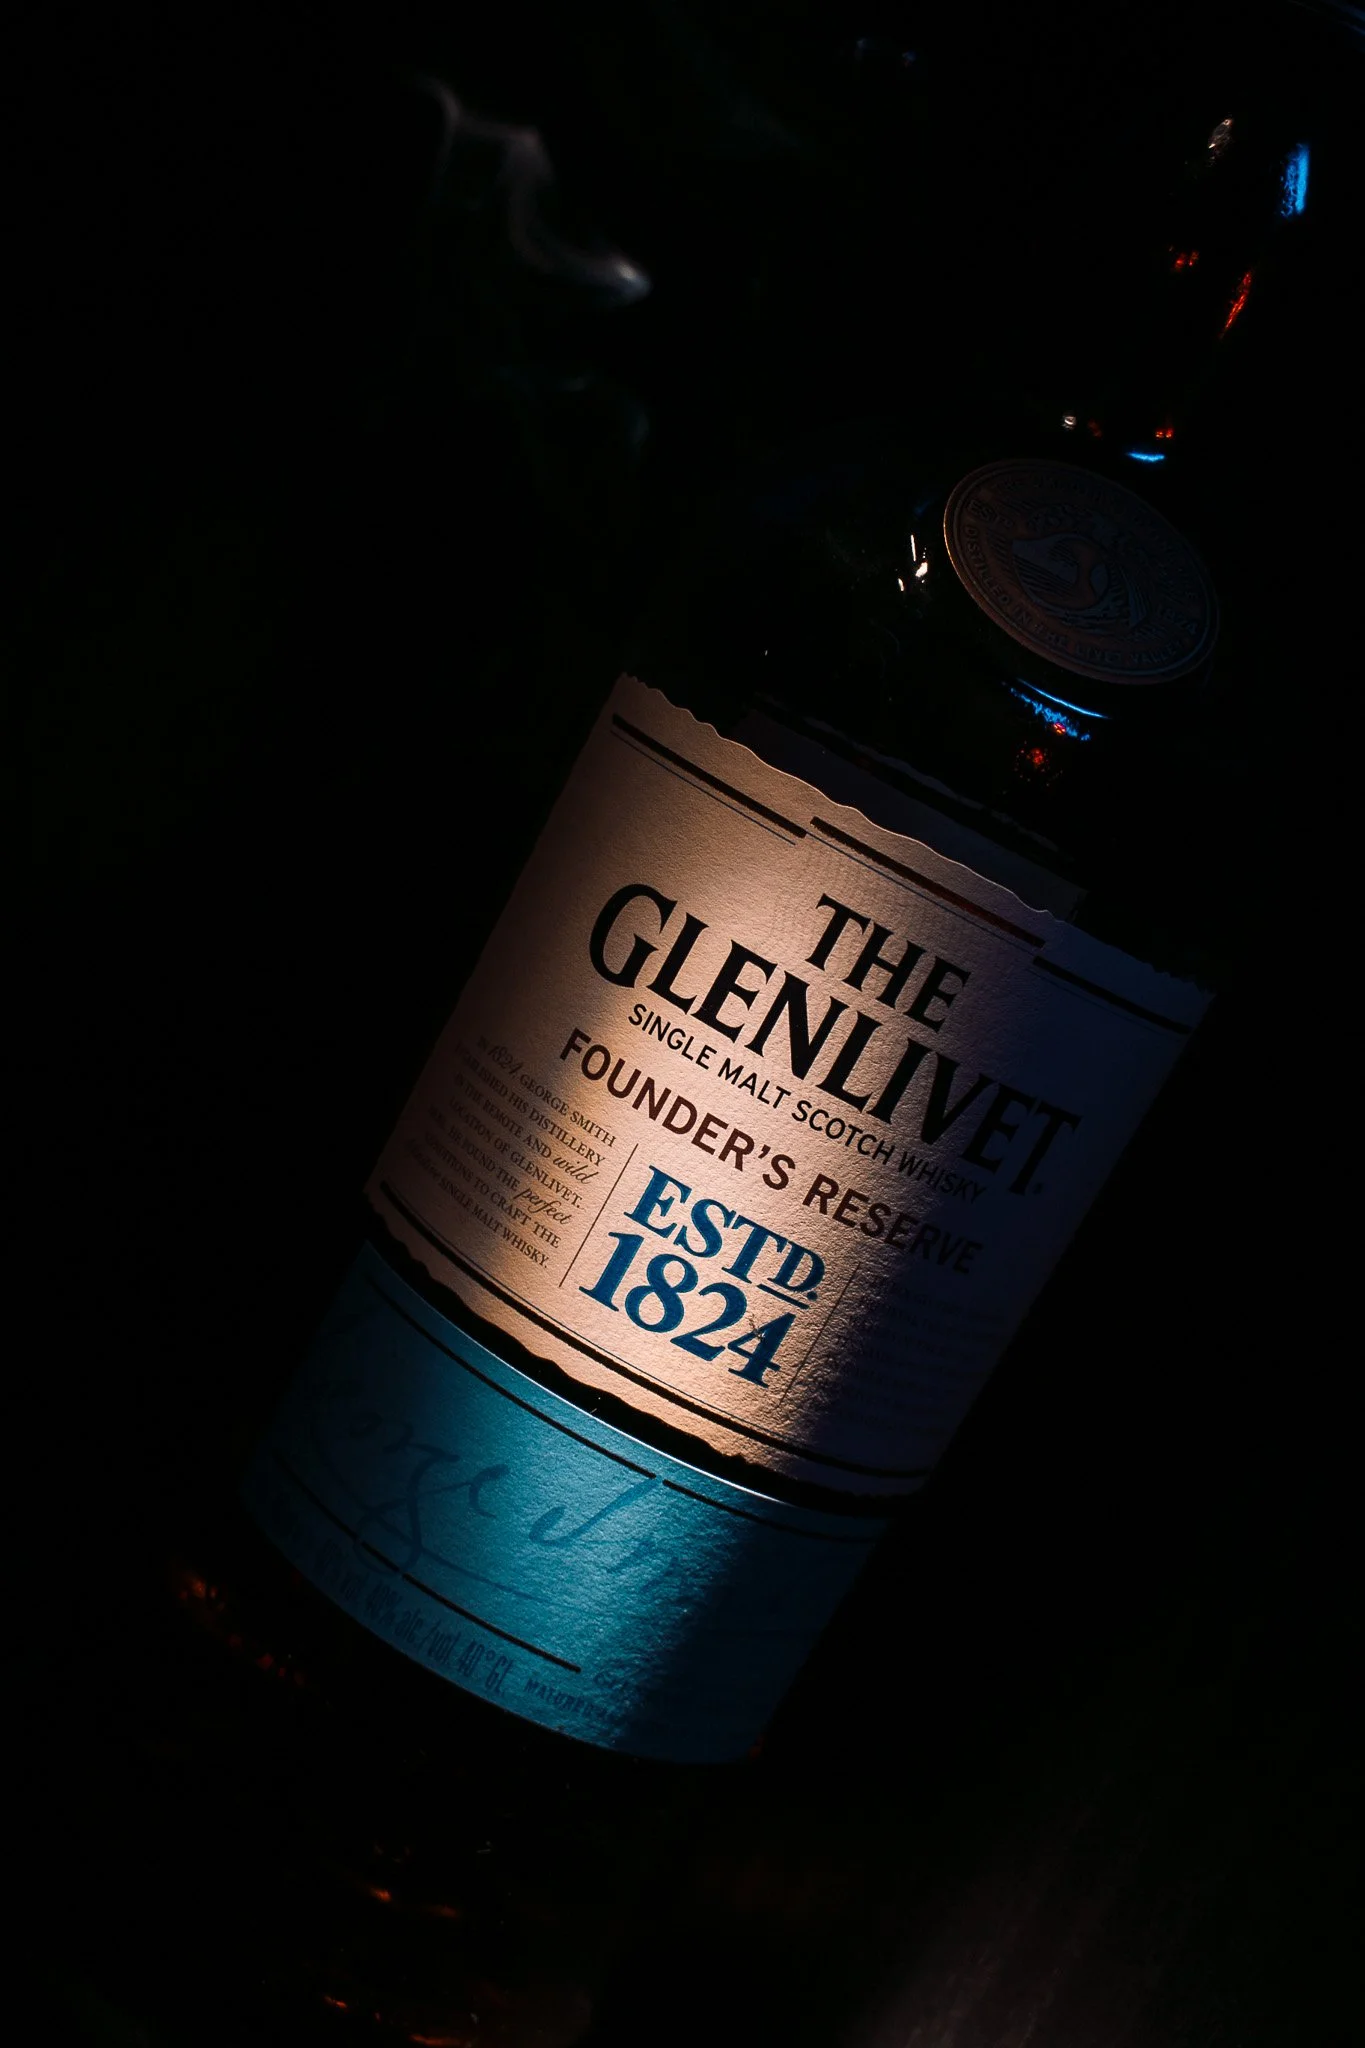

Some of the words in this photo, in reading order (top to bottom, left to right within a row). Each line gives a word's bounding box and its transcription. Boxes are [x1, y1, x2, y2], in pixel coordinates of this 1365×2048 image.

[805, 893, 971, 1034] THE
[589, 884, 1082, 1196] GLENLIVET
[447, 1095, 494, 1143] LOCATION
[492, 1137, 510, 1155] OF
[508, 1150, 583, 1208] GLENLIVET.
[481, 1099, 524, 1138] REMOTE
[522, 1132, 553, 1160] AND
[552, 1152, 599, 1187] wild
[507, 1092, 529, 1114] HIS
[527, 1107, 605, 1167] DISTILLERY
[517, 1072, 570, 1116] GEORGE
[568, 1110, 617, 1147] SMITH
[560, 1028, 795, 1190] FOUNDER'S
[802, 1173, 983, 1275] RESERVE
[628, 1004, 717, 1069] SINGLE
[718, 1058, 791, 1108] MALT
[792, 1100, 895, 1165] SCOTCH
[890, 1149, 988, 1204] WHISKY
[437, 1176, 476, 1212] SINGLE
[471, 1203, 503, 1233] MALT
[499, 1227, 549, 1268] WHISKY.
[460, 1138, 497, 1173] FOUND
[494, 1167, 521, 1192] THE
[513, 1186, 573, 1226] perfect
[471, 1176, 491, 1197] TO
[488, 1191, 531, 1227] CRAFT
[530, 1221, 562, 1249] THE
[579, 1232, 796, 1389] 1824
